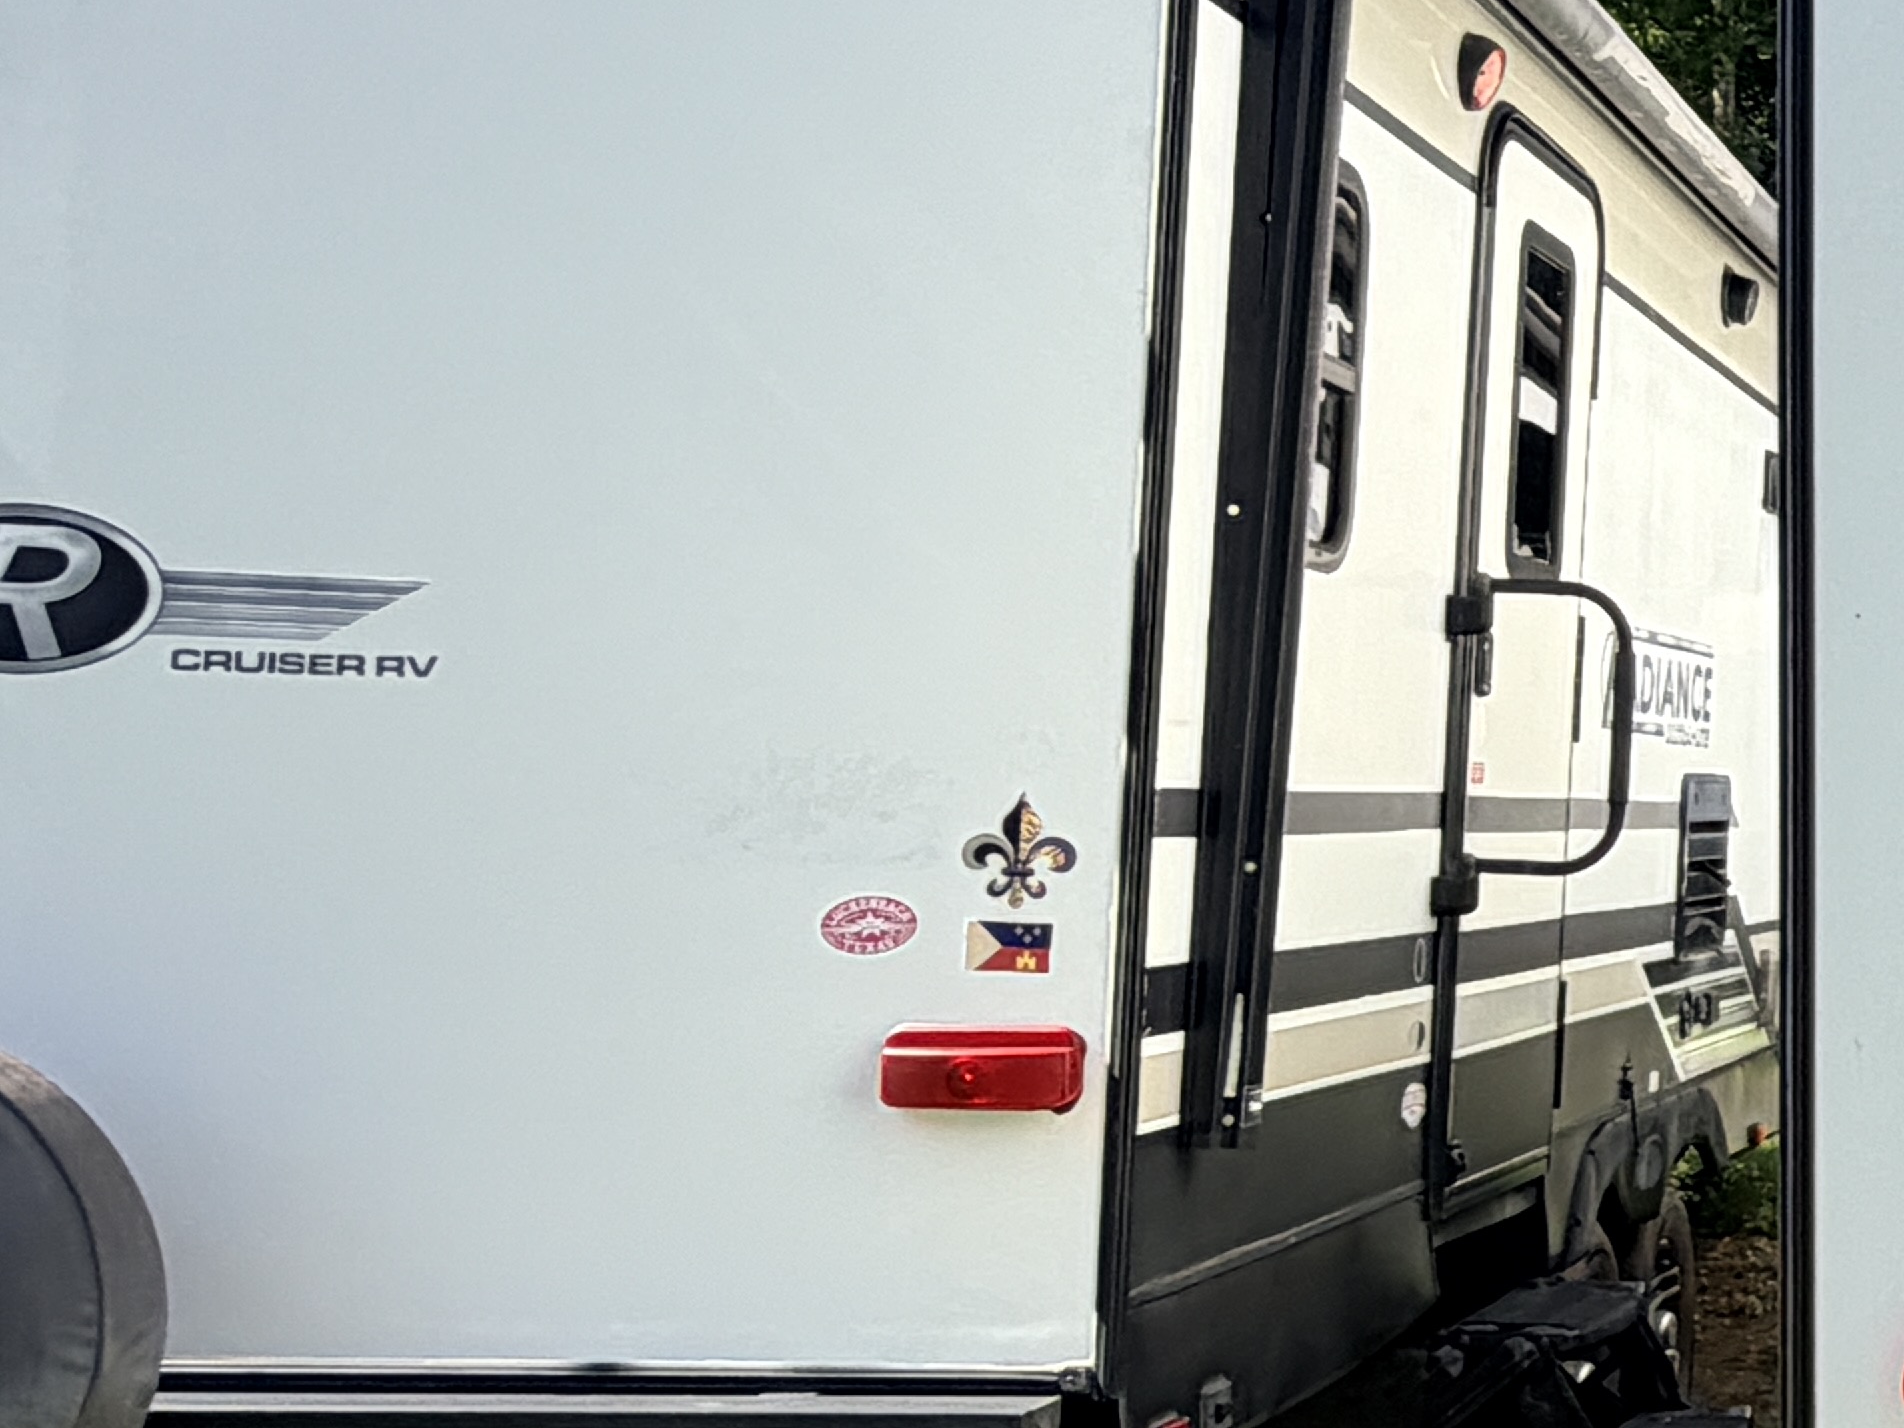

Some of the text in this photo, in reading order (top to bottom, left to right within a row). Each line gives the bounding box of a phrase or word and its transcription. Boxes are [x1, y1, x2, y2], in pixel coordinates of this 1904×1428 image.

[170, 648, 438, 679] CRUISER RV
[1634, 653, 1712, 723] DIANCE
